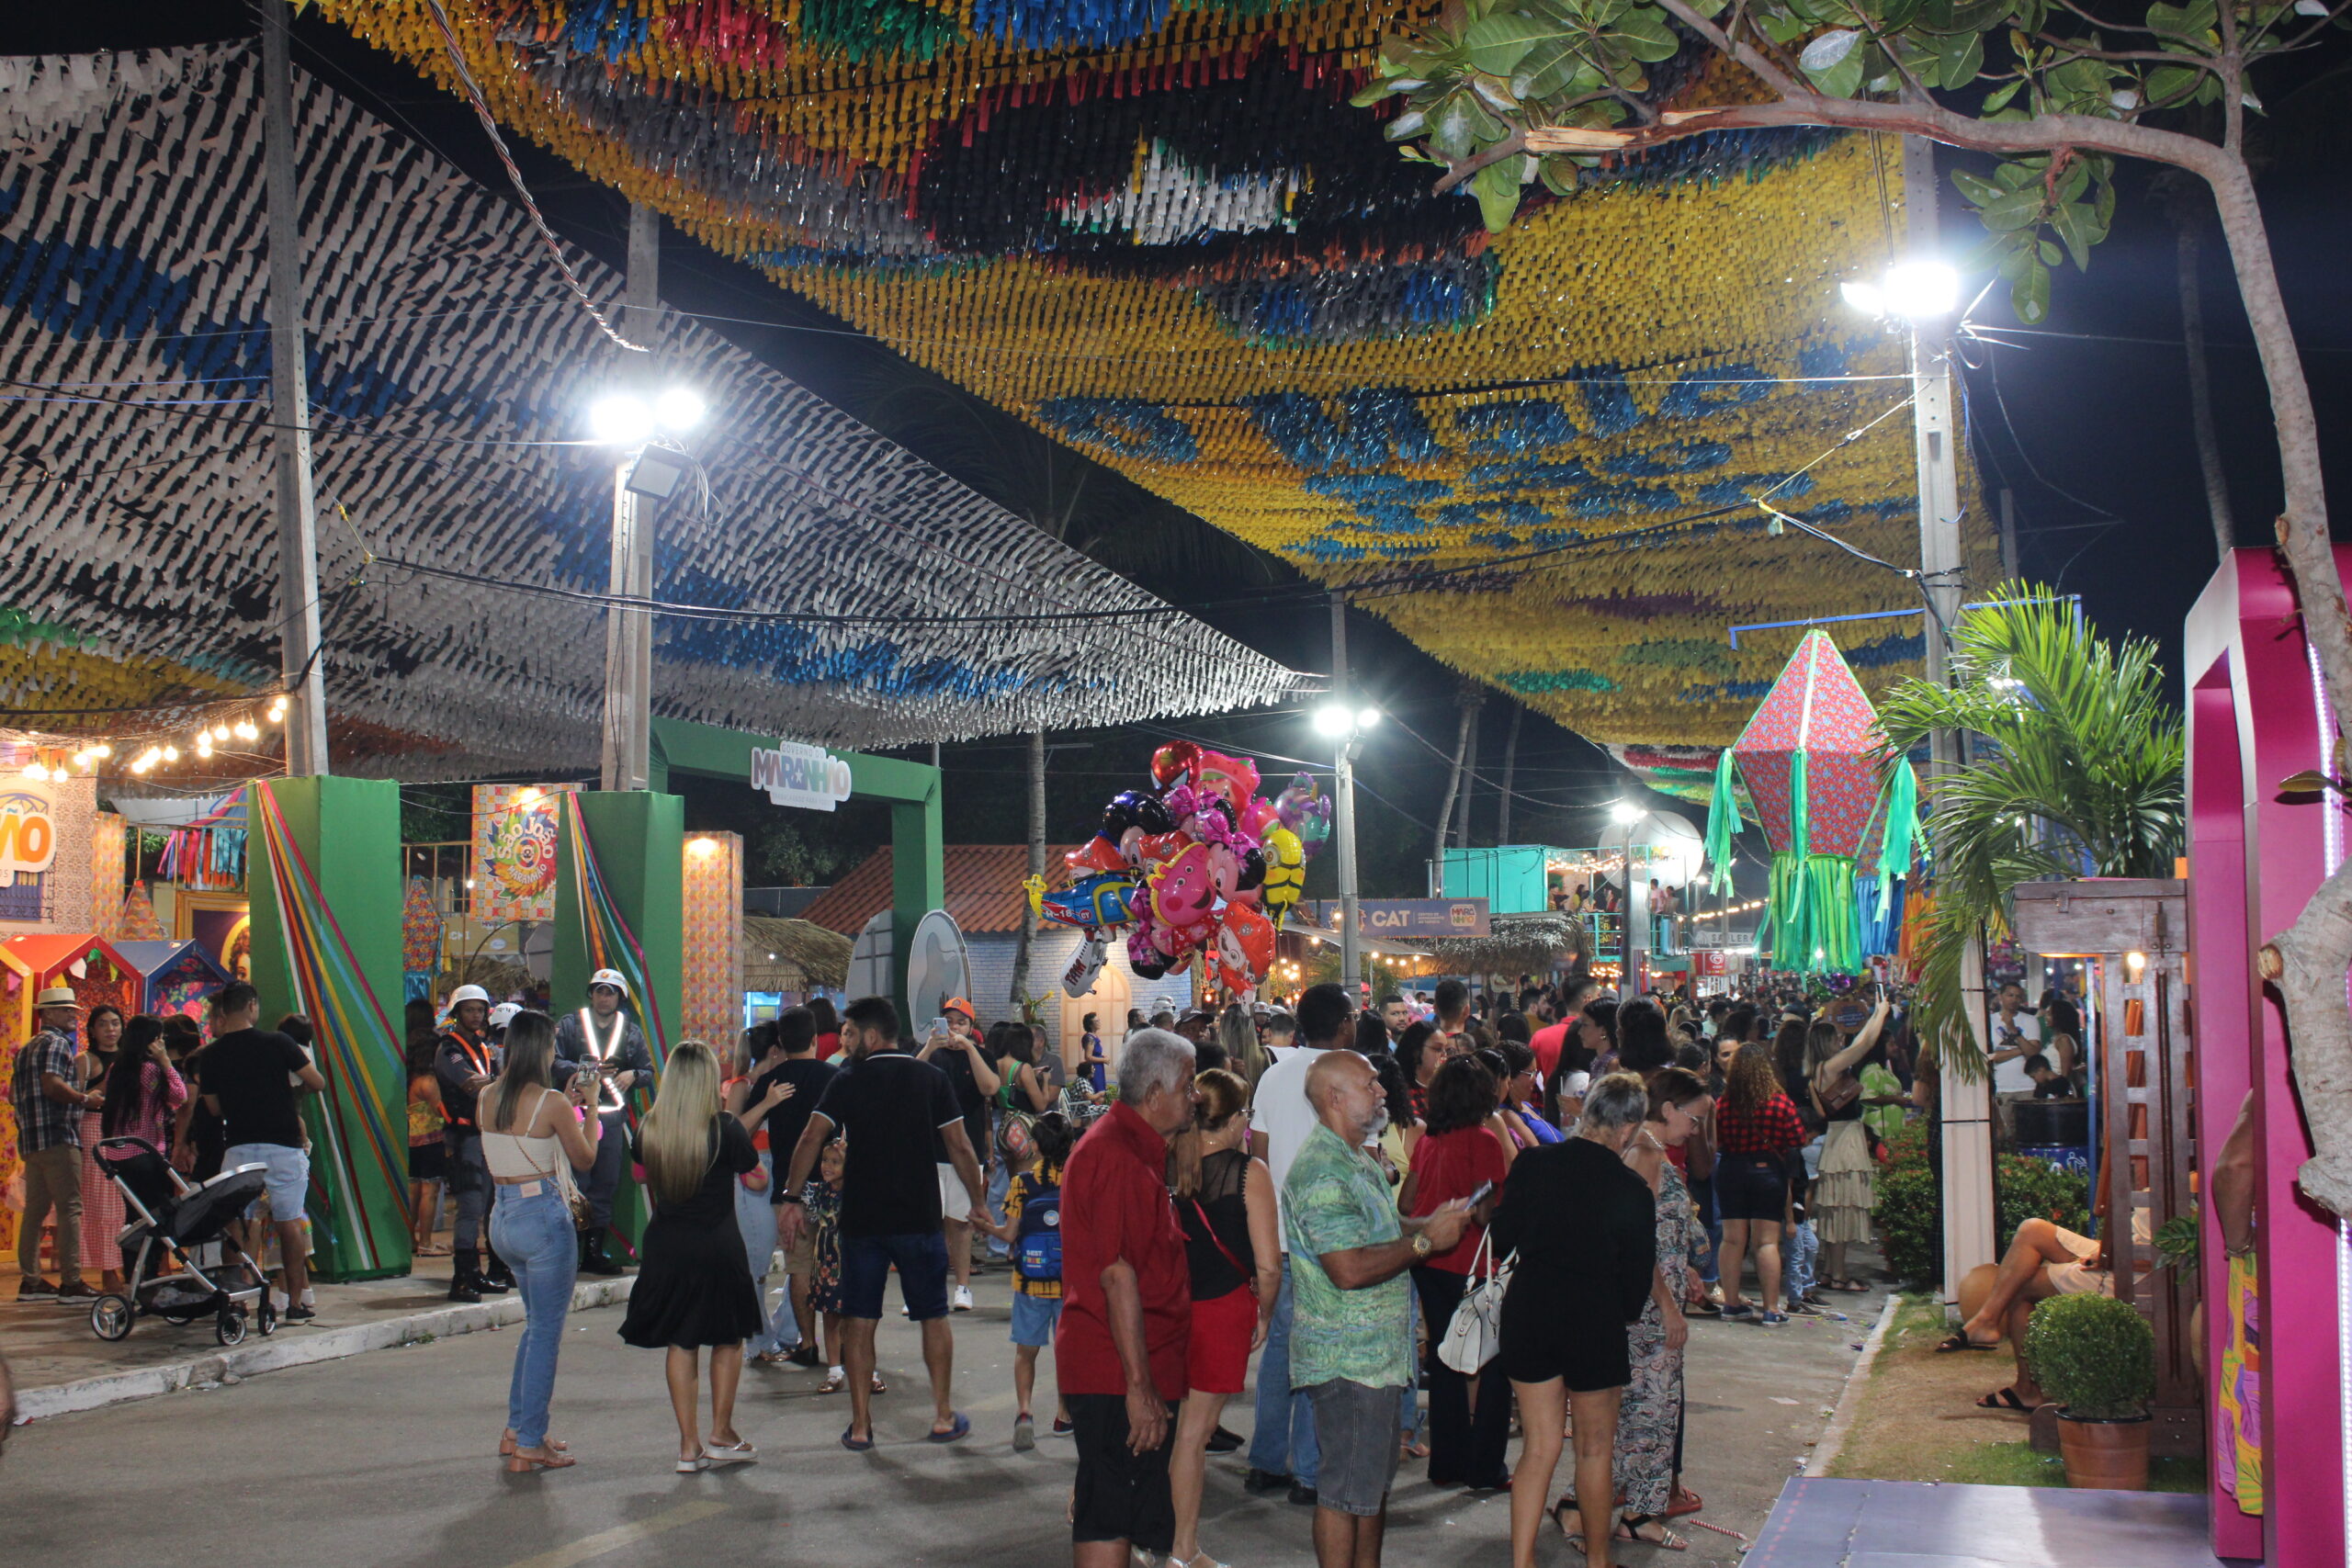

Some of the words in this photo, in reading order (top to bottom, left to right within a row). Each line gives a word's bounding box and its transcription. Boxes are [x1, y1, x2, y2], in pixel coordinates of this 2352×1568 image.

[781, 742, 813, 757] GOVERNO
[815, 748, 824, 758] DO
[753, 750, 849, 796] MARANHÃO
[498, 824, 523, 859] São
[525, 817, 557, 859] João
[507, 863, 548, 885] MARANHÃO
[1371, 910, 1410, 927] CAT
[1452, 908, 1476, 916] MARA
[1065, 958, 1087, 986] TAM
